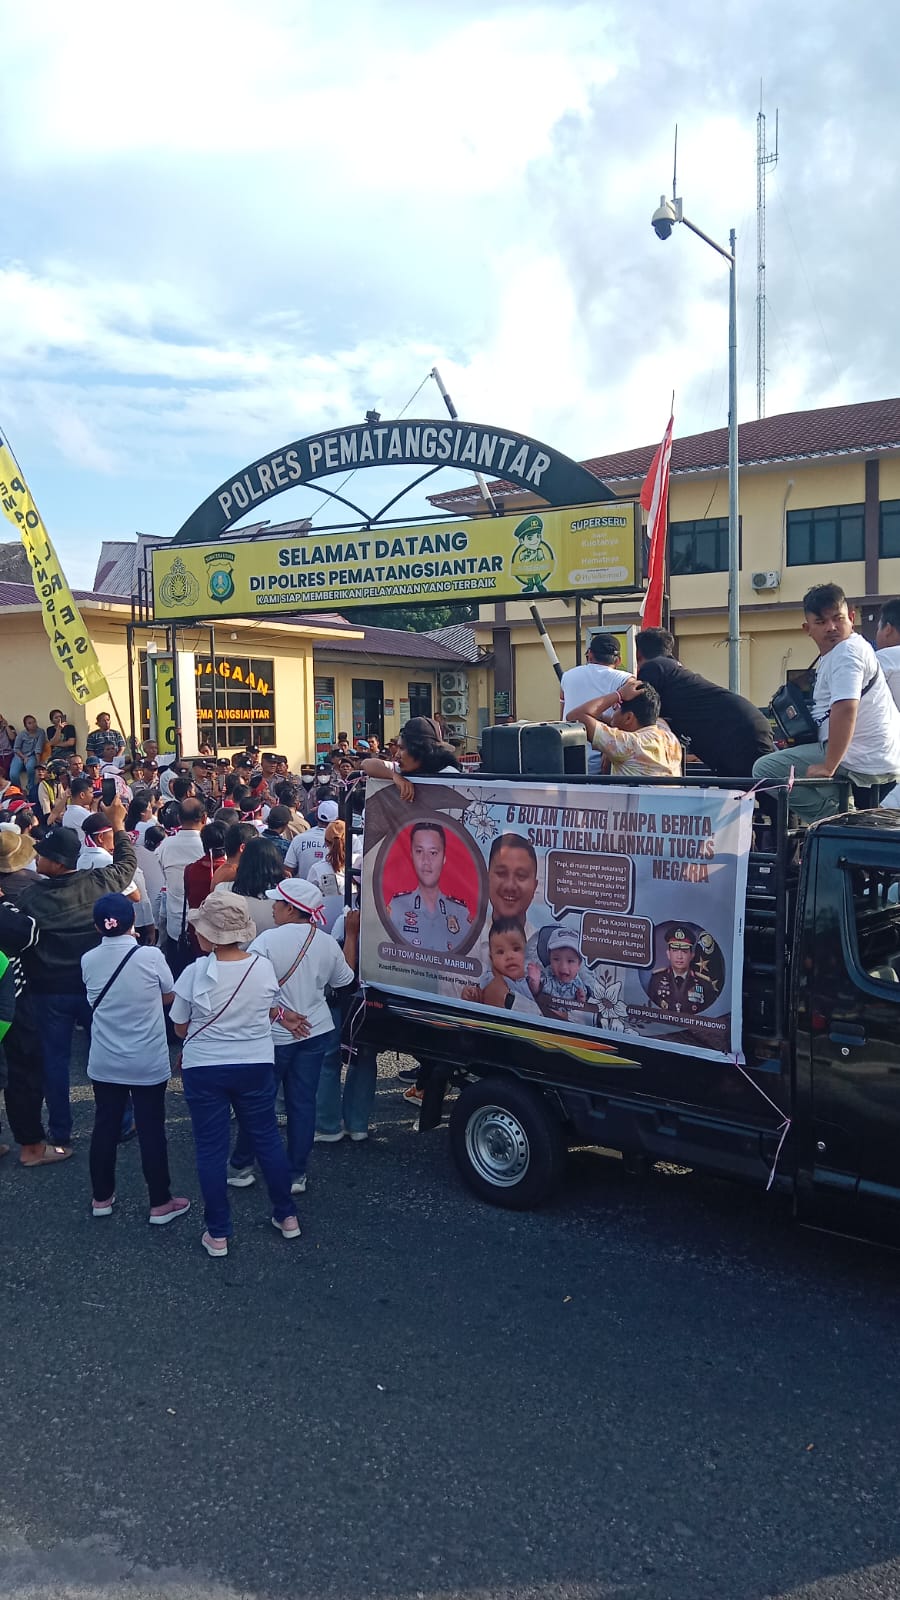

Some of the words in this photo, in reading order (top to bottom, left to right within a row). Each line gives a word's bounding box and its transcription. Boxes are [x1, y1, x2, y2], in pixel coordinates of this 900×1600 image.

[218, 450, 301, 519] POLRES
[309, 427, 551, 486] PEMATANGSIANTAR
[279, 541, 370, 566] SELAMAT
[376, 532, 468, 558] DATANG
[250, 576, 265, 591] DI
[269, 571, 325, 589] POLRES
[329, 556, 503, 586] PEMATANGSIANTAR
[256, 594, 281, 605] KAMI
[281, 592, 301, 603] SIAP
[302, 588, 362, 602] MEMBERIKAN
[363, 584, 421, 598] PELAYANAN
[422, 581, 451, 593] YANG
[453, 577, 496, 590] TERBAIK
[195, 662, 269, 696] JAGAAN
[506, 806, 515, 823] 6
[518, 806, 558, 826] BULAN
[561, 809, 608, 830] HILANG
[613, 812, 657, 833] TANPA
[661, 814, 715, 837] BERITA,
[528, 828, 559, 848] SAAT
[562, 831, 664, 857] MENJALANKAN
[668, 838, 714, 860] TUGAS
[652, 860, 709, 882] NEGARA
[382, 947, 397, 956] IPTU
[398, 949, 414, 959] TOMI
[416, 953, 441, 964] SAMUEL
[444, 958, 474, 971] MARBUN
[660, 1014, 679, 1023] LISTYO
[680, 1017, 695, 1026] SIGIT
[695, 1020, 727, 1030] PRABOWO
